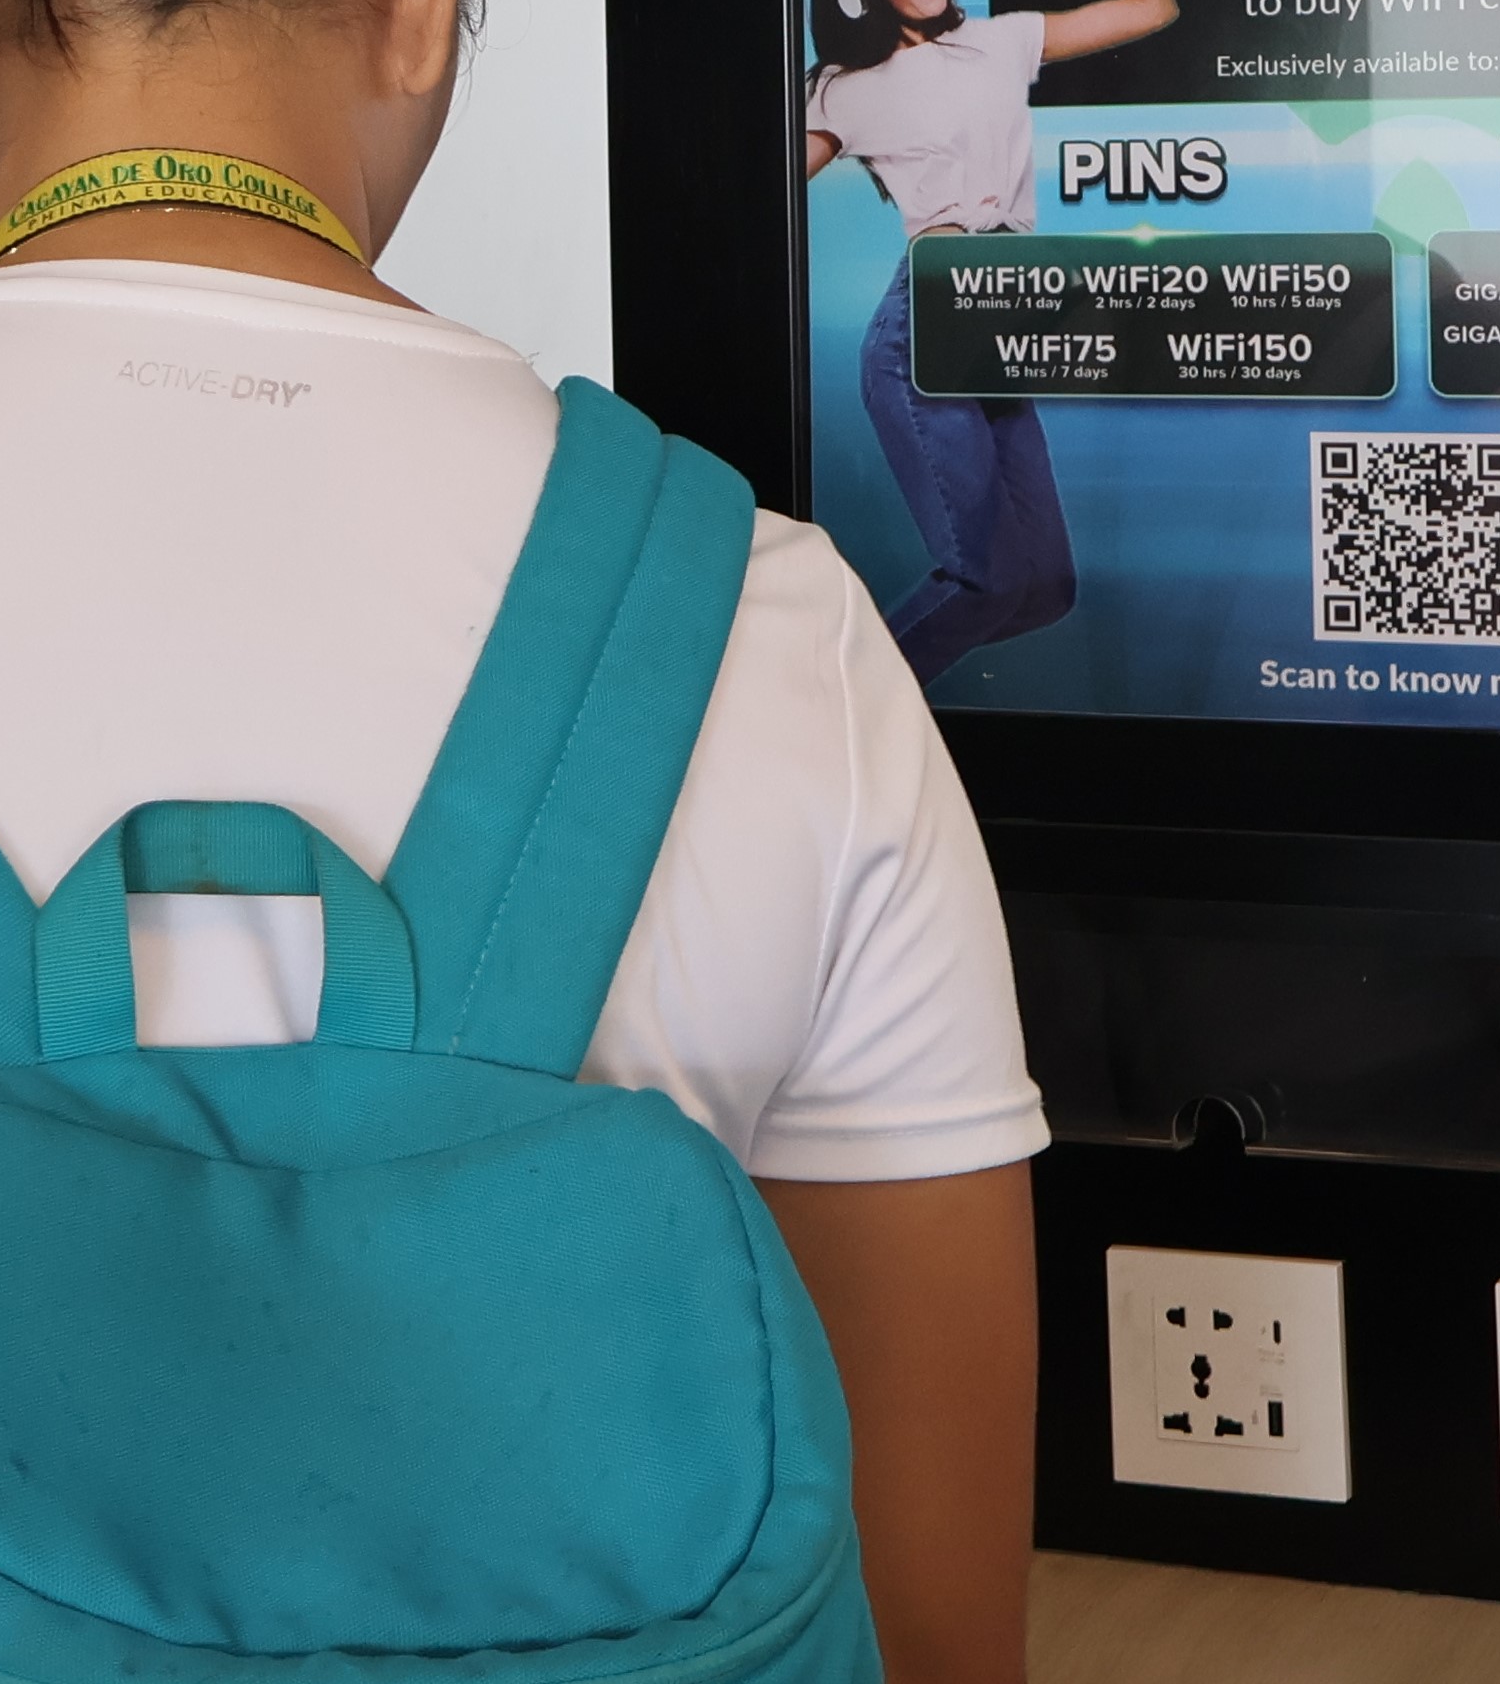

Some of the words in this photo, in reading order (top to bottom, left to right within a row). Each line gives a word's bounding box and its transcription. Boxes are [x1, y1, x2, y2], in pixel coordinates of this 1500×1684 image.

[1217, 53, 1346, 81] Exclusively
[1352, 50, 1460, 75] available
[1467, 50, 1500, 72] to:
[1061, 137, 1227, 204] PINS
[9, 171, 102, 229] CAGAYAN
[112, 162, 145, 184] DE
[153, 153, 212, 186] ORO
[223, 163, 319, 218] COLLEGE
[28, 189, 127, 231] PHINMA
[145, 185, 301, 222] EDUCATION
[951, 267, 1066, 294] WiFi10
[1083, 266, 1209, 294] WiFi20
[1221, 265, 1351, 293] WiFi50
[953, 297, 973, 310] 30
[977, 297, 1011, 310] mins
[1025, 297, 1032, 309] 1
[1035, 297, 1063, 312] day
[1095, 296, 1104, 309] 2
[1107, 296, 1132, 309] hrs
[1147, 296, 1156, 309] 2
[1160, 296, 1196, 312] days
[1231, 296, 1248, 309] 10
[1252, 296, 1277, 308] hrs
[1291, 296, 1301, 308] 5
[1305, 295, 1342, 311] days
[996, 334, 1116, 362] WiFi75
[1167, 333, 1312, 362] WiFi150
[1003, 366, 1021, 378] 15
[1024, 366, 1047, 378] hrs
[1061, 366, 1070, 378] 7
[1074, 366, 1108, 381] days
[1179, 366, 1199, 379] 30
[1203, 366, 1227, 379] hrs
[1241, 366, 1261, 379] 30
[1265, 366, 1301, 381] days
[1260, 660, 1336, 689] Scan
[1345, 664, 1381, 691] to
[1389, 664, 1481, 694] know
